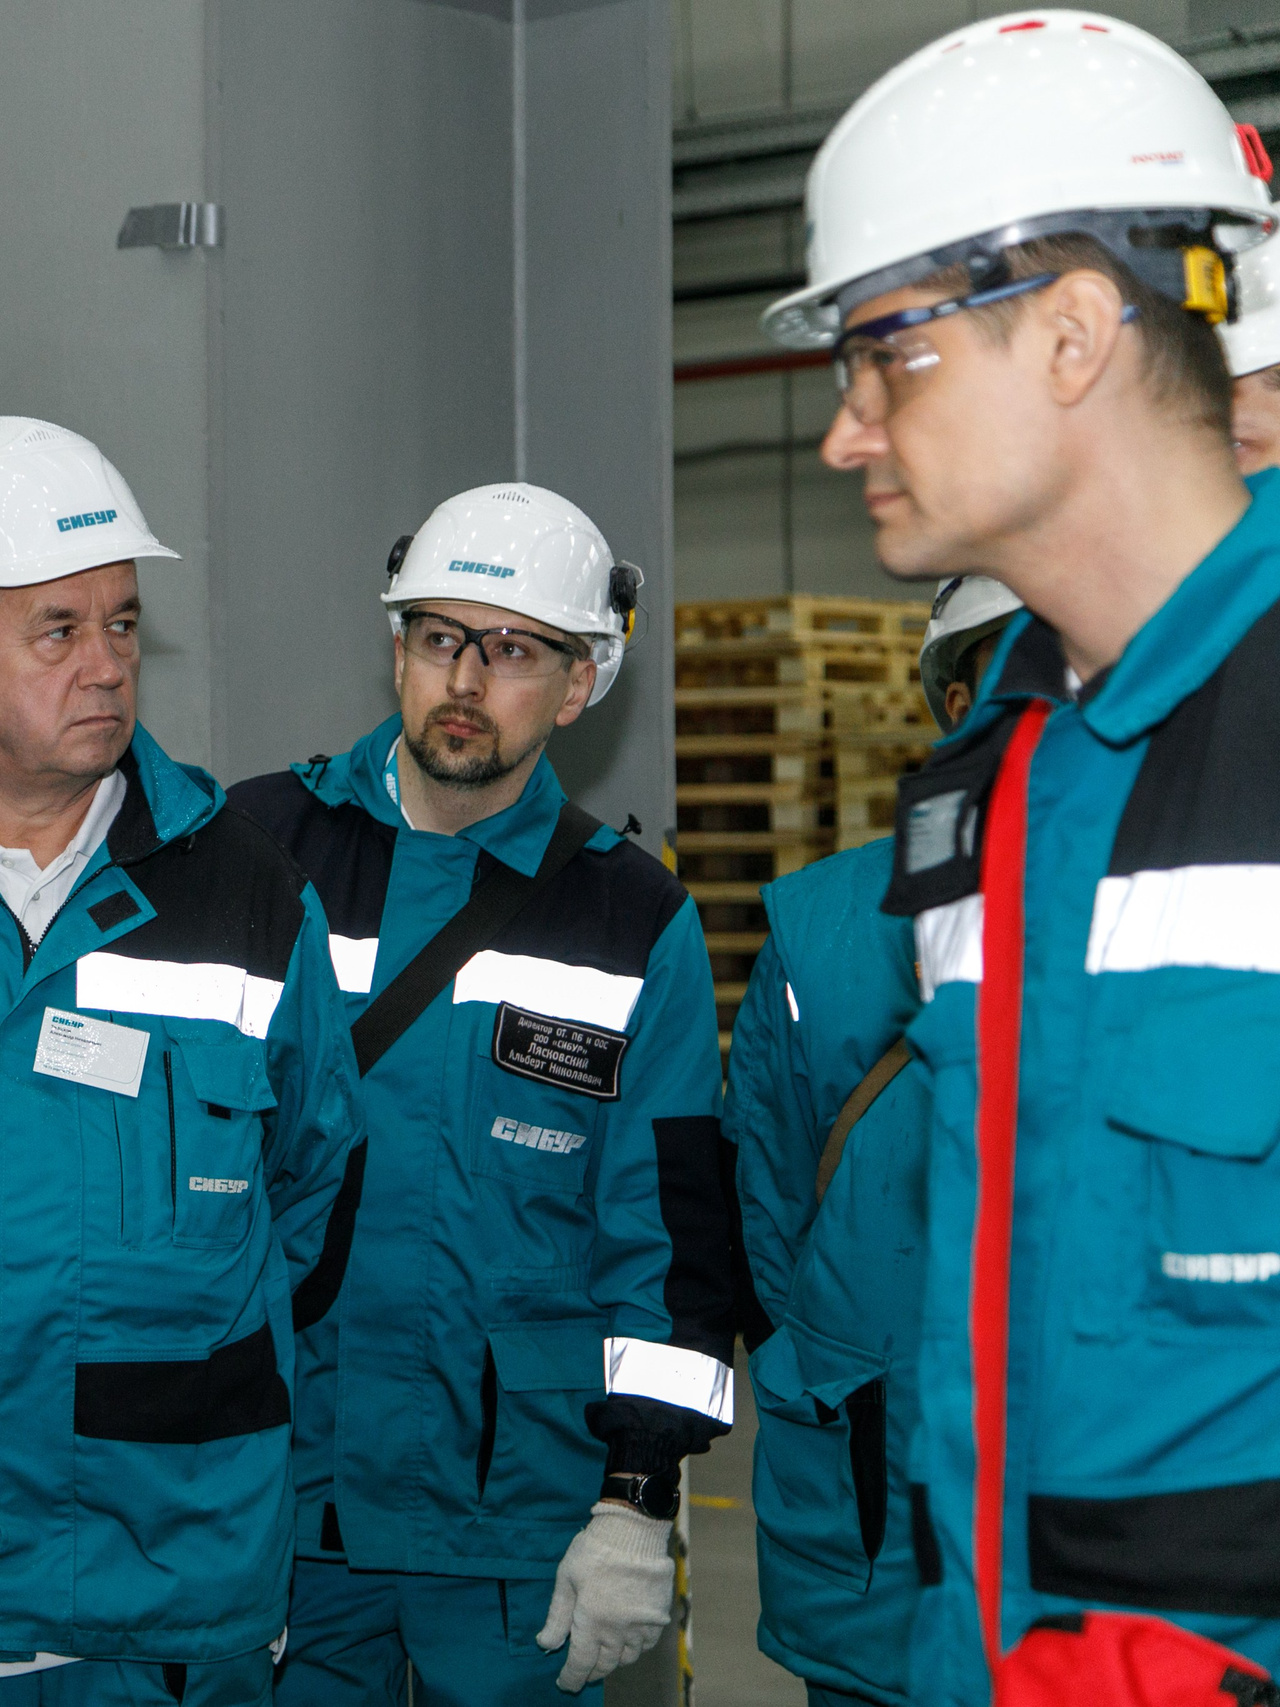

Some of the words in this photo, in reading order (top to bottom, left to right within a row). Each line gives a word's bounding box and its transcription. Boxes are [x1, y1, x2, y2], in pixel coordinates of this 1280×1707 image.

[57, 509, 118, 532] СИБУР
[448, 560, 516, 578] СИБУР
[518, 1016, 553, 1035] Директор
[594, 1038, 609, 1050] ООС
[533, 1033, 549, 1044] ООО
[508, 1049, 547, 1070] Альберт
[549, 1061, 603, 1087] Николаевич
[527, 1042, 590, 1070] Лясковский
[490, 1115, 587, 1154] СИБУР
[189, 1176, 249, 1193] СИБУР
[1162, 1252, 1280, 1283] СИБУР
